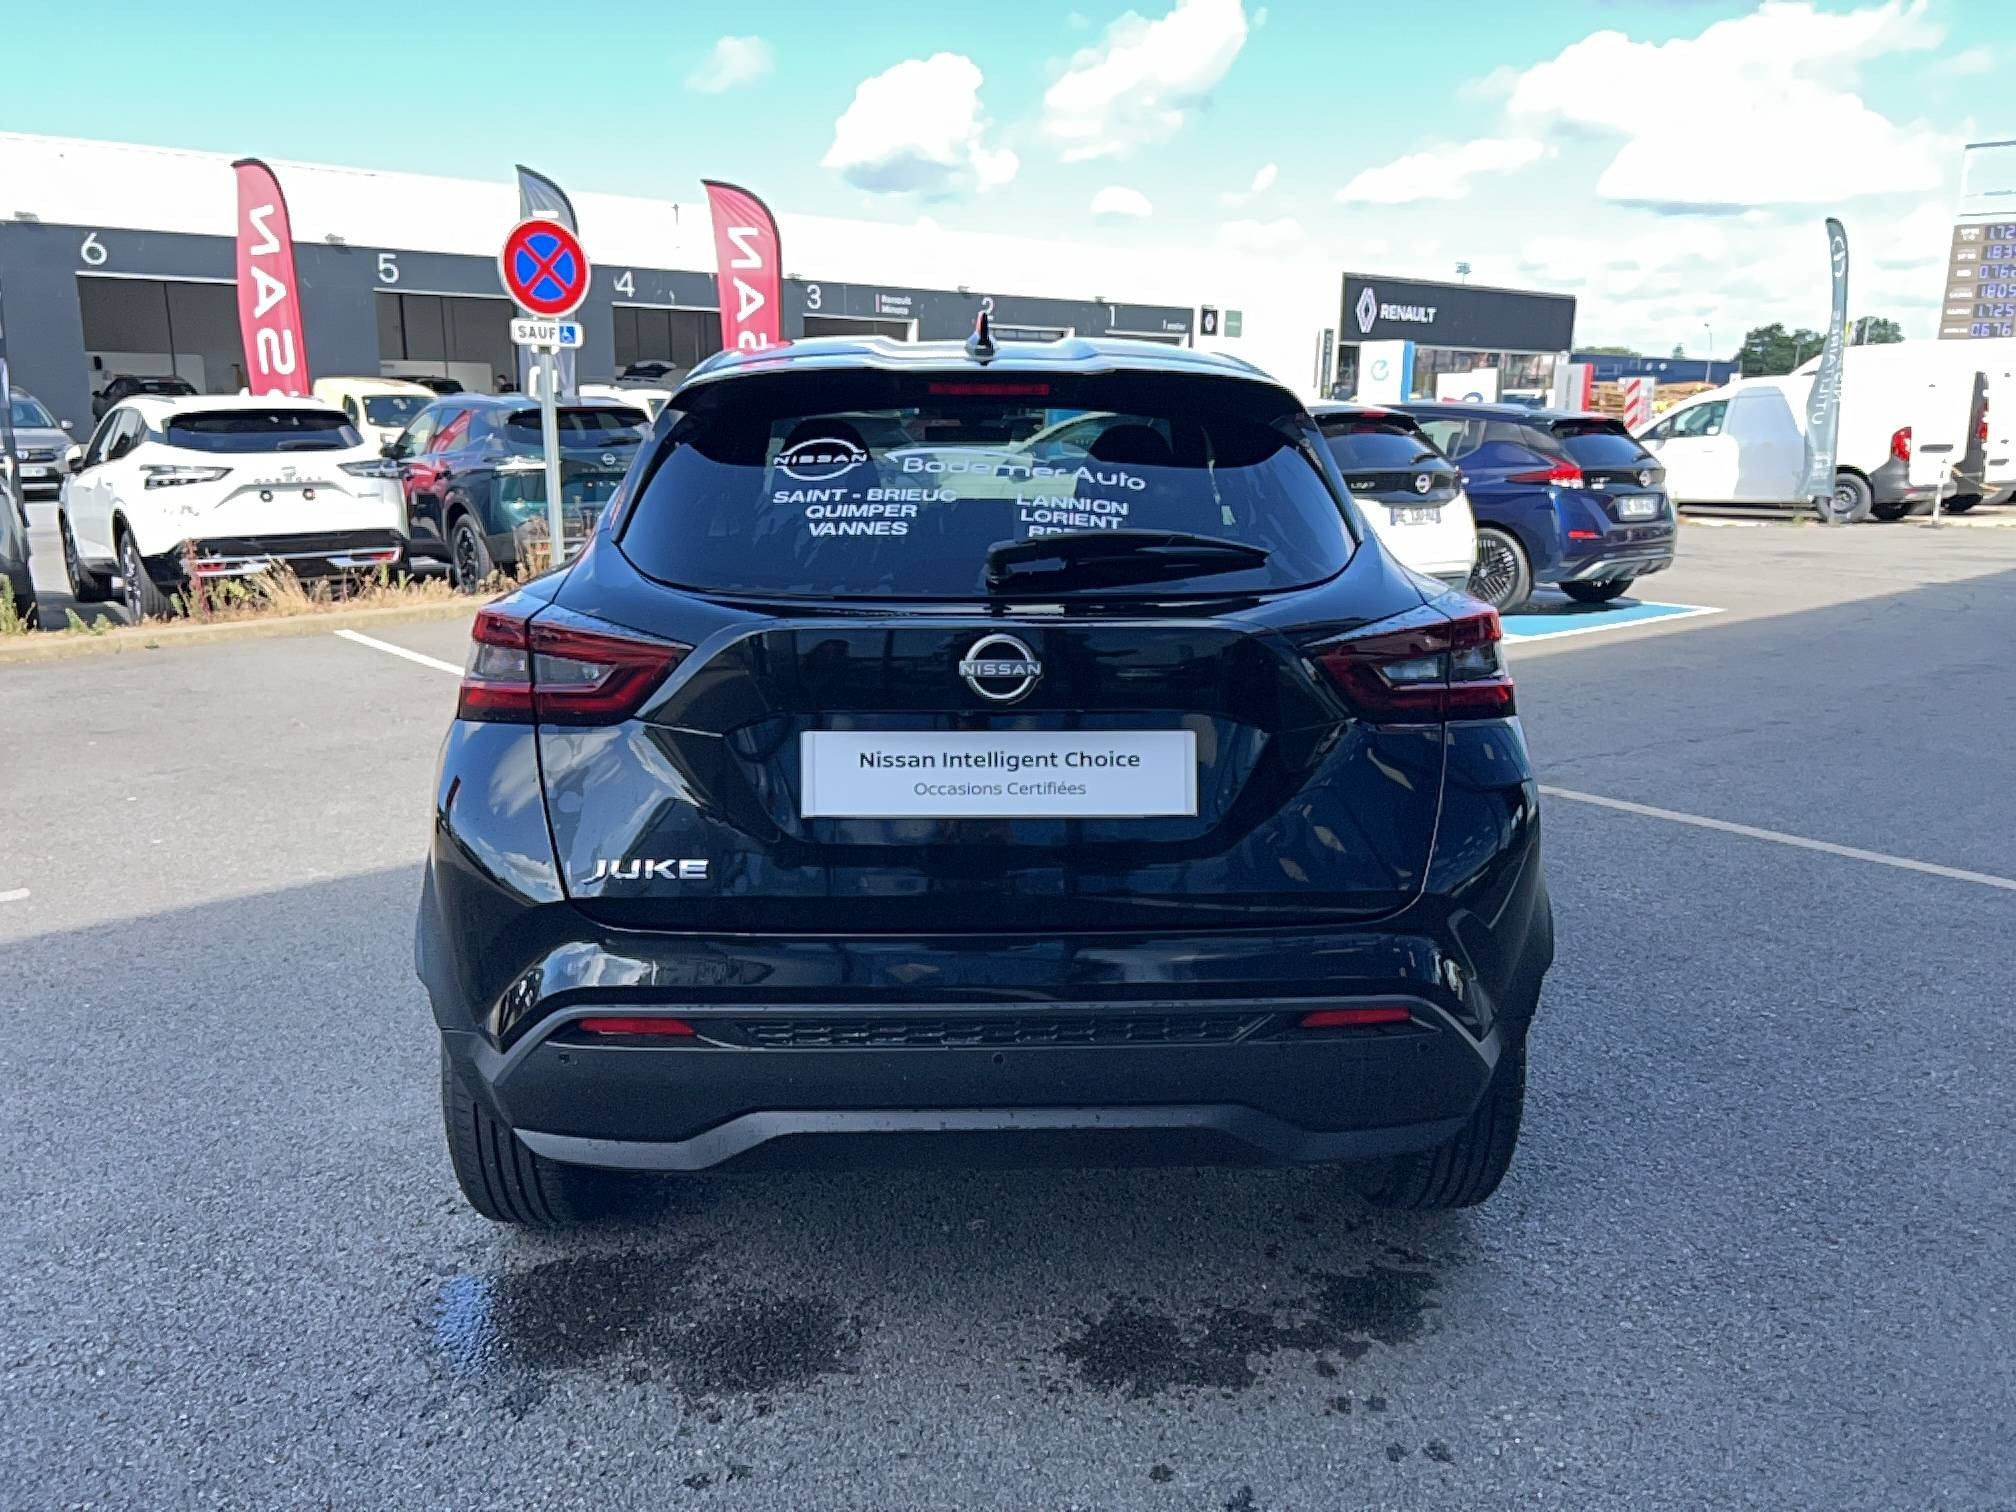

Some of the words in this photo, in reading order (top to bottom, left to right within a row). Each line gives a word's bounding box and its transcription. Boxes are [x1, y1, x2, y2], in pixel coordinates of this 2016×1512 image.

[81, 232, 107, 265] 6
[378, 253, 399, 283] 5
[613, 271, 635, 297] 4
[806, 284, 822, 310] 3
[1109, 305, 1116, 327] 1
[1379, 303, 1437, 323] RENAULT
[517, 325, 557, 340] SAUF
[773, 454, 868, 465] NISSAN
[902, 458, 1067, 478] Bodemer
[1073, 466, 1146, 490] Auto
[772, 488, 848, 503] SAINT
[866, 488, 958, 502] BRIEUC
[1016, 493, 1129, 516] LANNION
[806, 504, 918, 518] QUIMPER
[1020, 508, 1123, 530] LORIENT
[809, 521, 908, 537] VANNES
[960, 663, 1040, 676] NISSAN
[859, 751, 935, 768] Nissan
[942, 751, 1058, 772] Intelligent
[1065, 751, 1140, 768] Choice
[913, 782, 1002, 796] Occasions
[1006, 781, 1087, 796] Certifiées
[580, 859, 709, 881] JUKE
